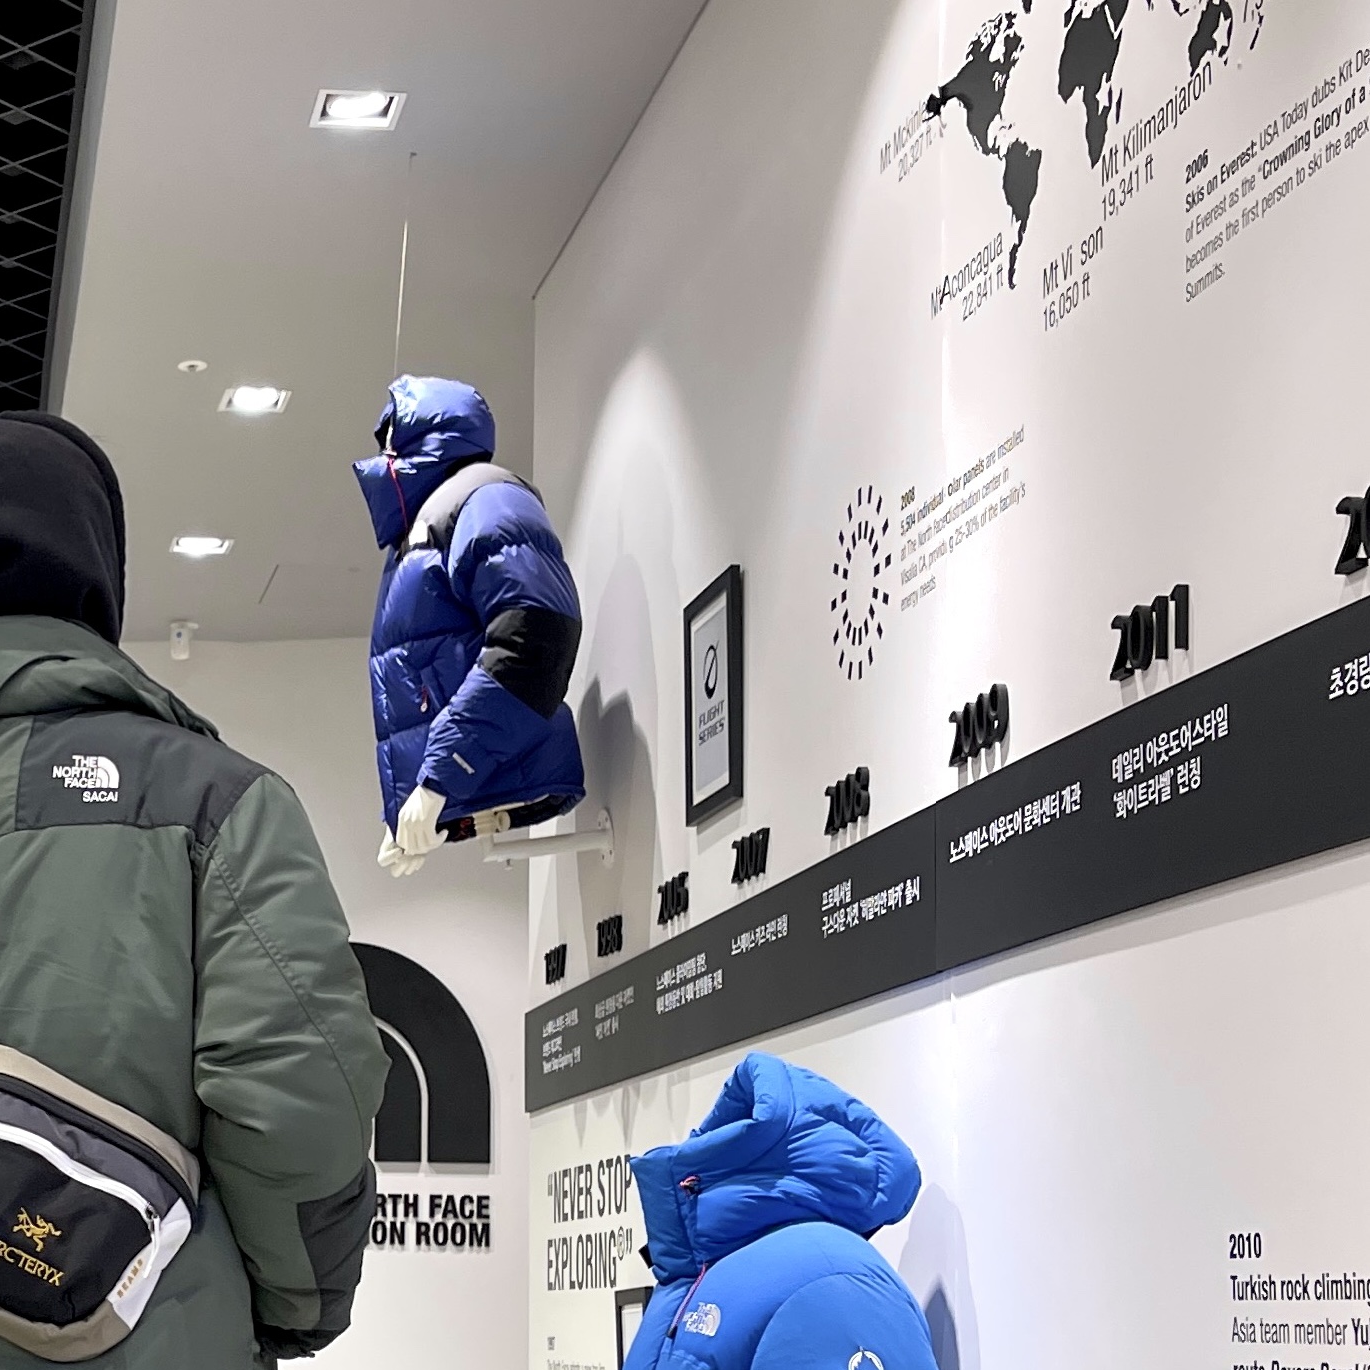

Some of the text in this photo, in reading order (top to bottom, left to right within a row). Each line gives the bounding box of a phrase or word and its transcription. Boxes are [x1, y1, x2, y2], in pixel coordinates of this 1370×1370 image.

[1101, 61, 1213, 188] Mt Kilimanjaron
[1185, 185, 1205, 213] Skis
[1207, 174, 1218, 196] on
[1259, 119, 1279, 151] USA
[1280, 97, 1309, 133] Today
[1311, 75, 1336, 109] dubs
[1338, 57, 1353, 87] Kit
[1102, 153, 1154, 221] 19,341 ft
[1185, 219, 1194, 244] of
[1195, 195, 1227, 236] Everest
[1228, 187, 1239, 209] as
[1241, 173, 1256, 198] the
[1313, 103, 1342, 139] Glory
[1344, 87, 1356, 115] of
[1359, 86, 1366, 104] a
[1185, 148, 1209, 184] 2006
[1185, 116, 1370, 274] becomes the first person to ski the apex
[939, 232, 1003, 306] Aconcagua
[962, 263, 1004, 322] 22,841 ft
[1043, 259, 1058, 300] Mt
[1185, 262, 1226, 303] Summits.
[1043, 271, 1091, 332] 16,050 ft
[1110, 583, 1189, 681] 2011
[698, 699, 725, 730] FLIGHT
[698, 716, 725, 747] SERIES
[949, 683, 1010, 767] 2009
[72, 755, 97, 768] THE
[1111, 703, 1229, 783] 데일리 아웃도어스타일
[52, 766, 97, 779] NORTH
[64, 778, 97, 789] FACE
[82, 790, 118, 803] SACAI
[1177, 755, 1202, 795] 런칭
[824, 766, 870, 837] 2008
[949, 781, 1082, 863] 노스페이스 아웃도어 문화센터 개관
[731, 827, 770, 884] 2007
[657, 871, 689, 926] 2005
[429, 1194, 490, 1219] FACE
[597, 1154, 631, 1215] STOP
[372, 1221, 490, 1248] ON ROOM
[1229, 1233, 1262, 1259] 2010
[1230, 1274, 1277, 1301] Turkish
[1281, 1274, 1310, 1301] rock
[1232, 1316, 1370, 1350] Asia team member Yu
